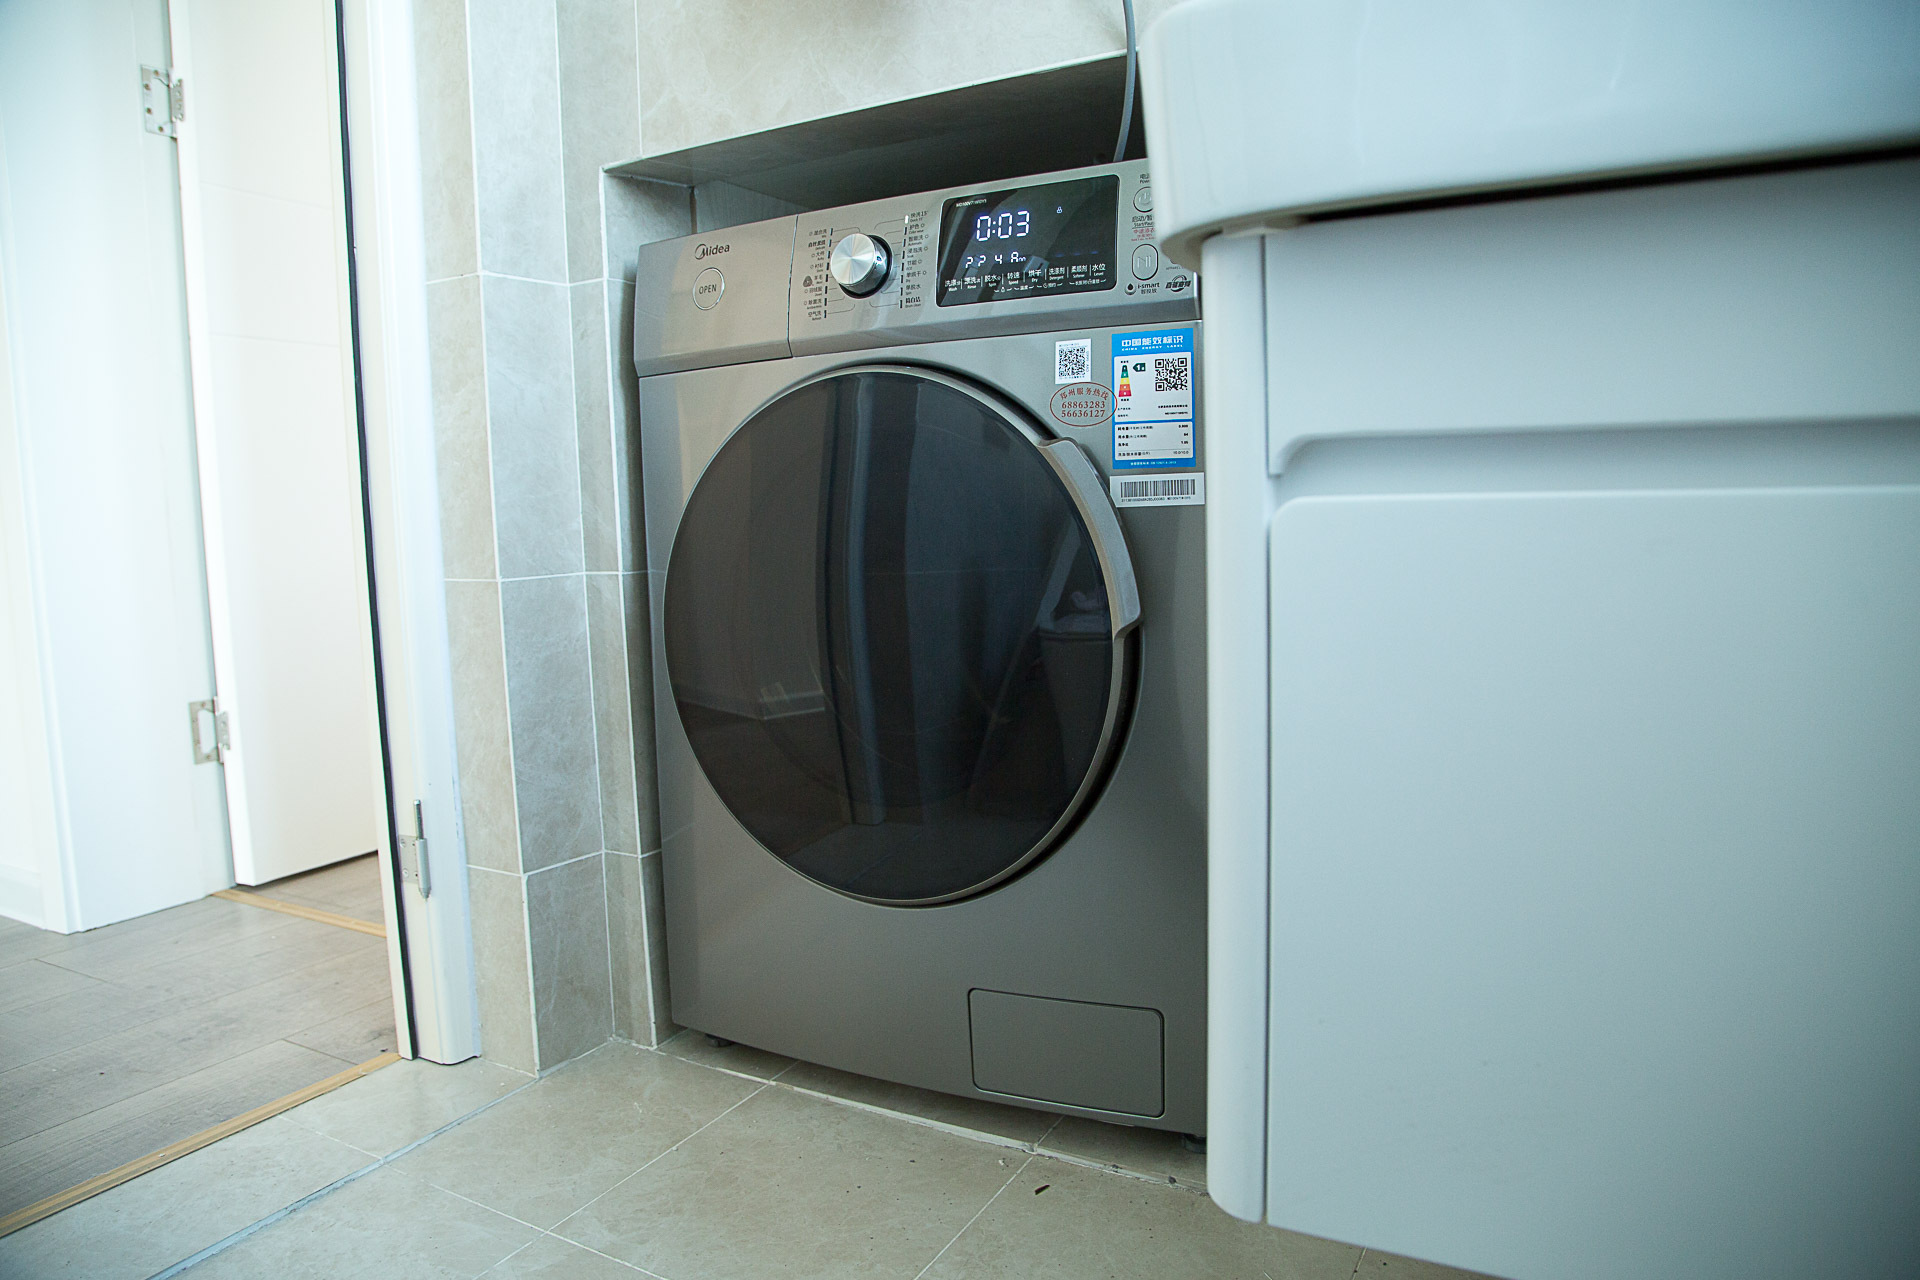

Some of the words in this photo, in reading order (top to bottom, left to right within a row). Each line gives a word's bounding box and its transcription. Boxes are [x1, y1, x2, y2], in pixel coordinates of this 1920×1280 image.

[976, 210, 1030, 242] 0:03
[695, 244, 730, 260] Midea
[994, 254, 1002, 264] 4
[1049, 267, 1065, 275] 洗涤剂
[1092, 263, 1106, 272] 水位
[699, 284, 717, 294] OPEN
[1122, 336, 1183, 346] 中国能效标识
[1060, 388, 1109, 400] 郑州服务热线
